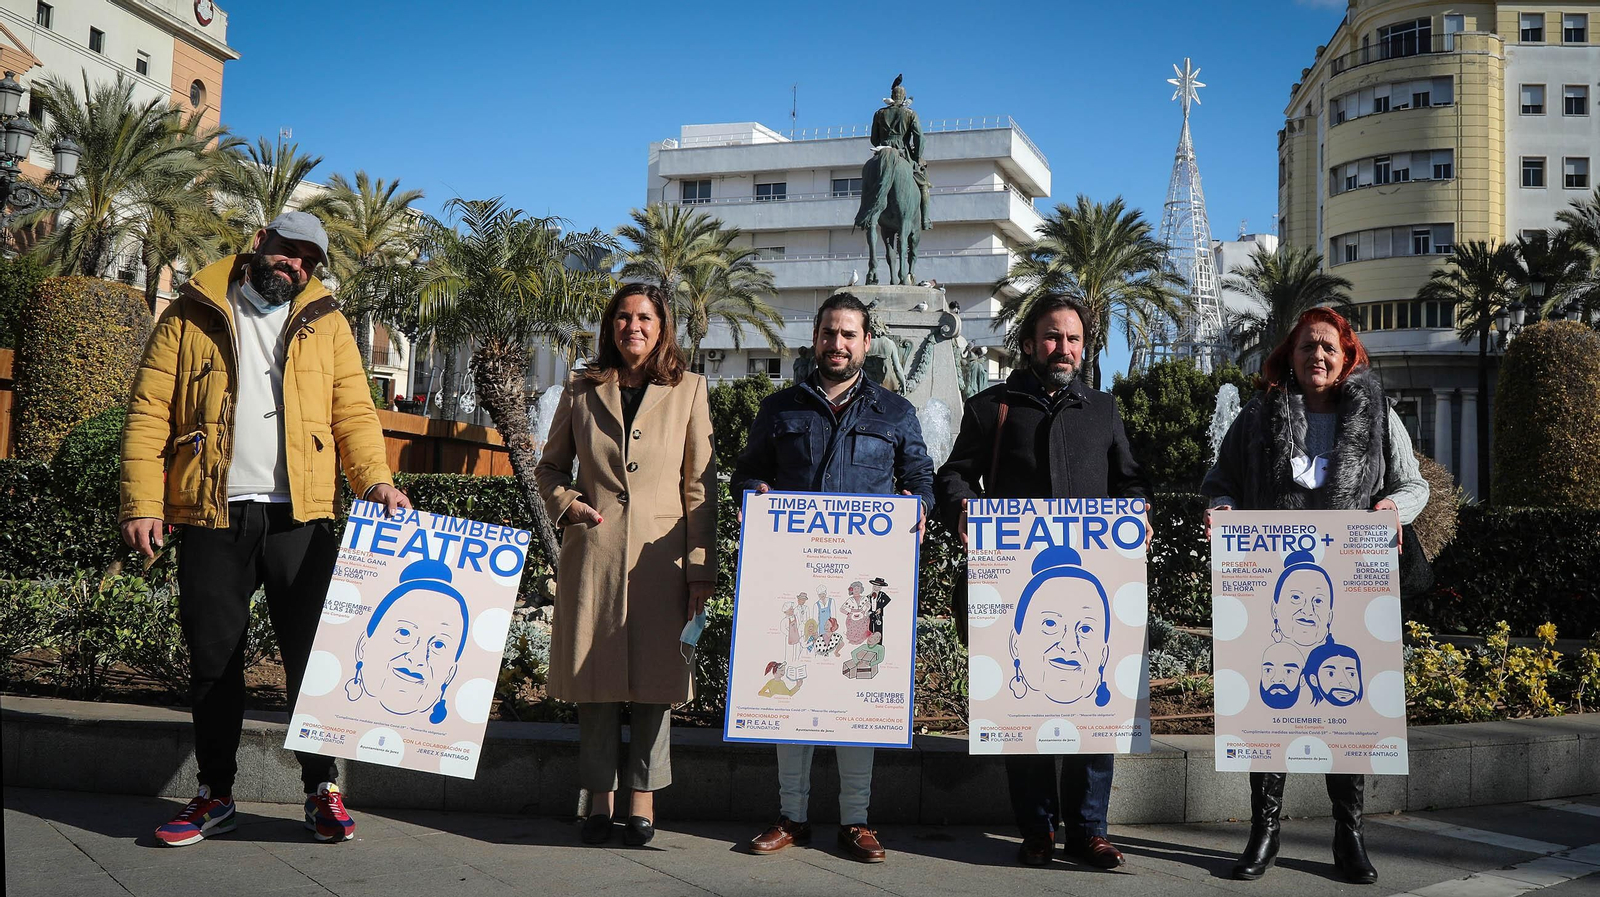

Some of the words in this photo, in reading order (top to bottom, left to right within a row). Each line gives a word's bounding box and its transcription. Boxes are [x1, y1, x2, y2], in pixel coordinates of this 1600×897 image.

[769, 498, 817, 510] TIMBA
[823, 500, 894, 512] TIMBERO
[968, 498, 1037, 515] TIMBA
[1044, 498, 1146, 515] TIMBERO
[352, 500, 421, 526] TIMBA
[430, 513, 531, 545] TIMBERO
[768, 510, 892, 536] TEATRO
[968, 516, 1146, 550] TEATRO
[1222, 525, 1258, 534] TIMBA
[1262, 525, 1316, 534] TIMBERO
[348, 516, 524, 577] TEATRO
[1222, 534, 1316, 552] TEATRO
[339, 547, 373, 557] PRESENTA
[367, 558, 386, 566] GANA
[344, 567, 378, 577] CUARTITO
[344, 572, 364, 580] HORA
[334, 601, 372, 612] DICIEMBRE
[303, 722, 345, 732] PROMOCIONADO
[310, 736, 344, 744] FOUNDATION
[311, 730, 345, 740] REALE
[422, 742, 462, 752] COLABORACIÓN
[440, 752, 469, 760] SANTIAGO
